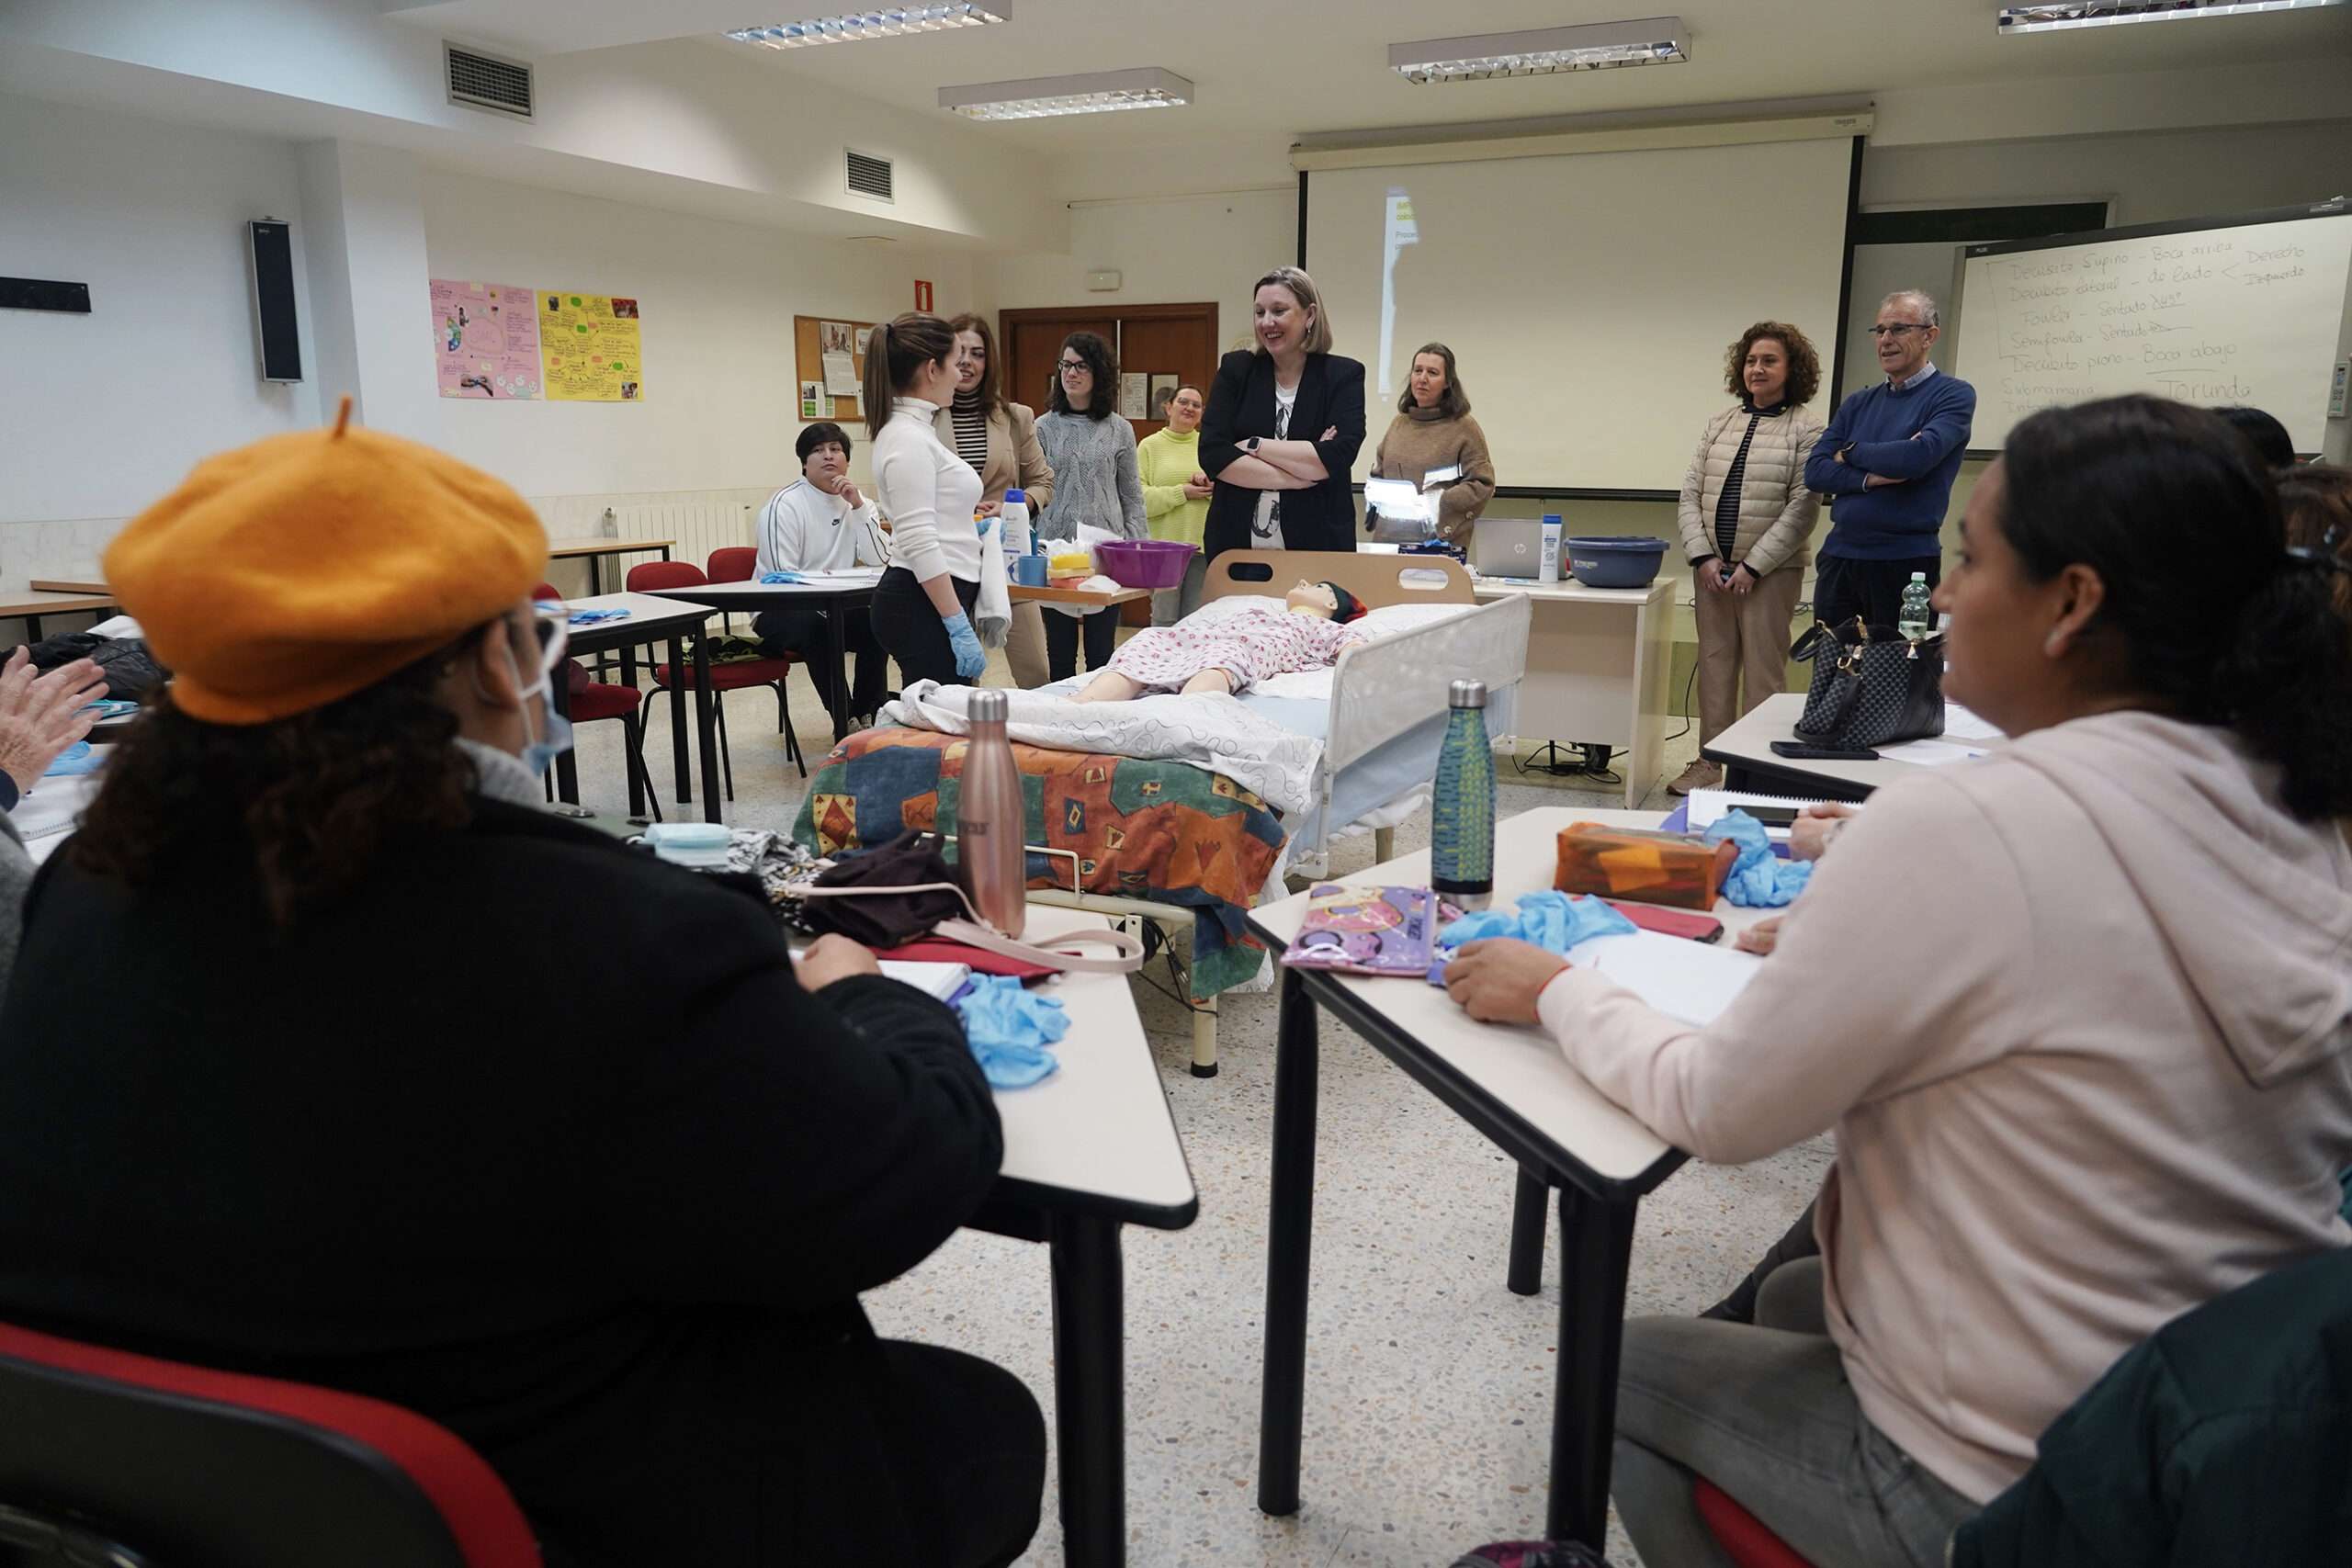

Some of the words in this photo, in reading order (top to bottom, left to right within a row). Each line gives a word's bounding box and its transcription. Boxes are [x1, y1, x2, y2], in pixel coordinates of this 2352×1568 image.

[2173, 265, 2213, 282] lado
[2143, 344, 2181, 364] Boca
[2189, 341, 2236, 364] abajo
[2155, 375, 2251, 400] Torunda
